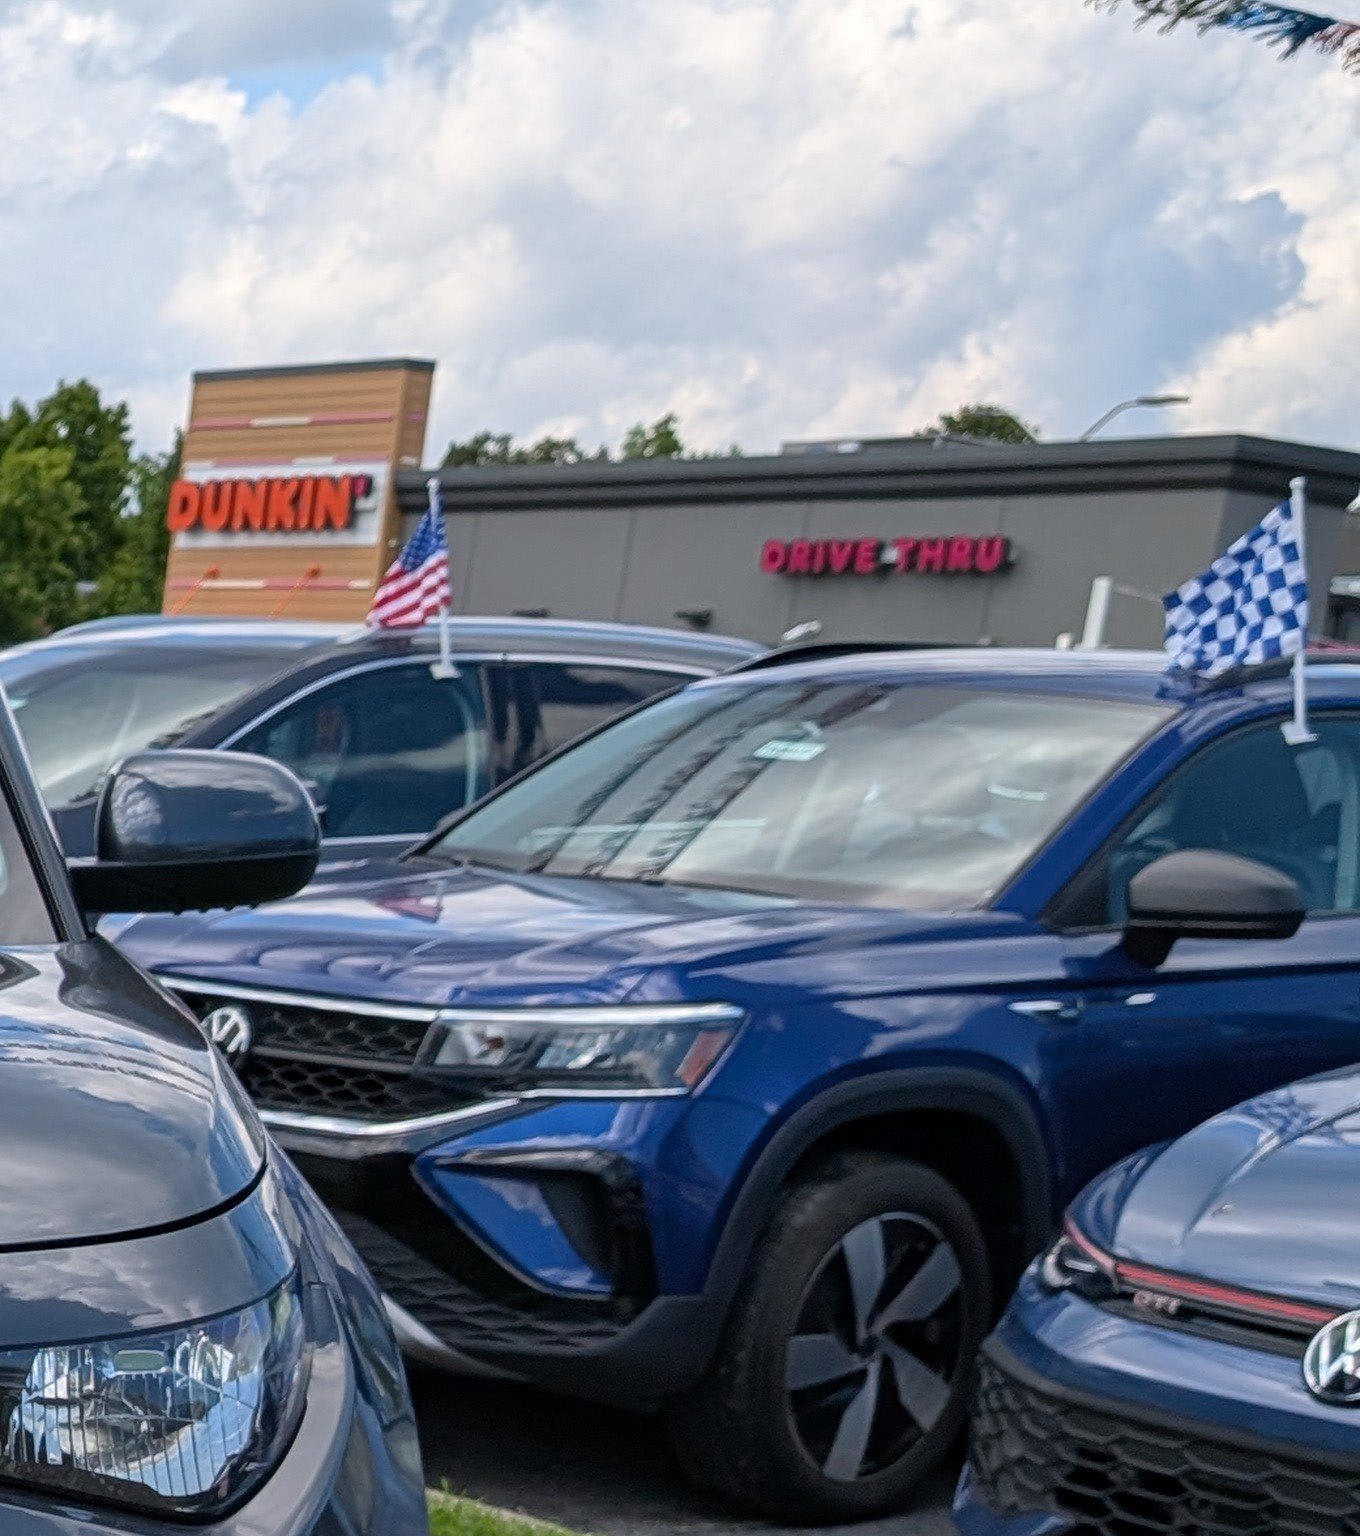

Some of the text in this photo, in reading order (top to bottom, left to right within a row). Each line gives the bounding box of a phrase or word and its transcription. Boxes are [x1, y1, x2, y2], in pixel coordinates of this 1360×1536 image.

[166, 473, 369, 533] DUNKIN'
[760, 533, 1006, 574] DRIVE THRU
